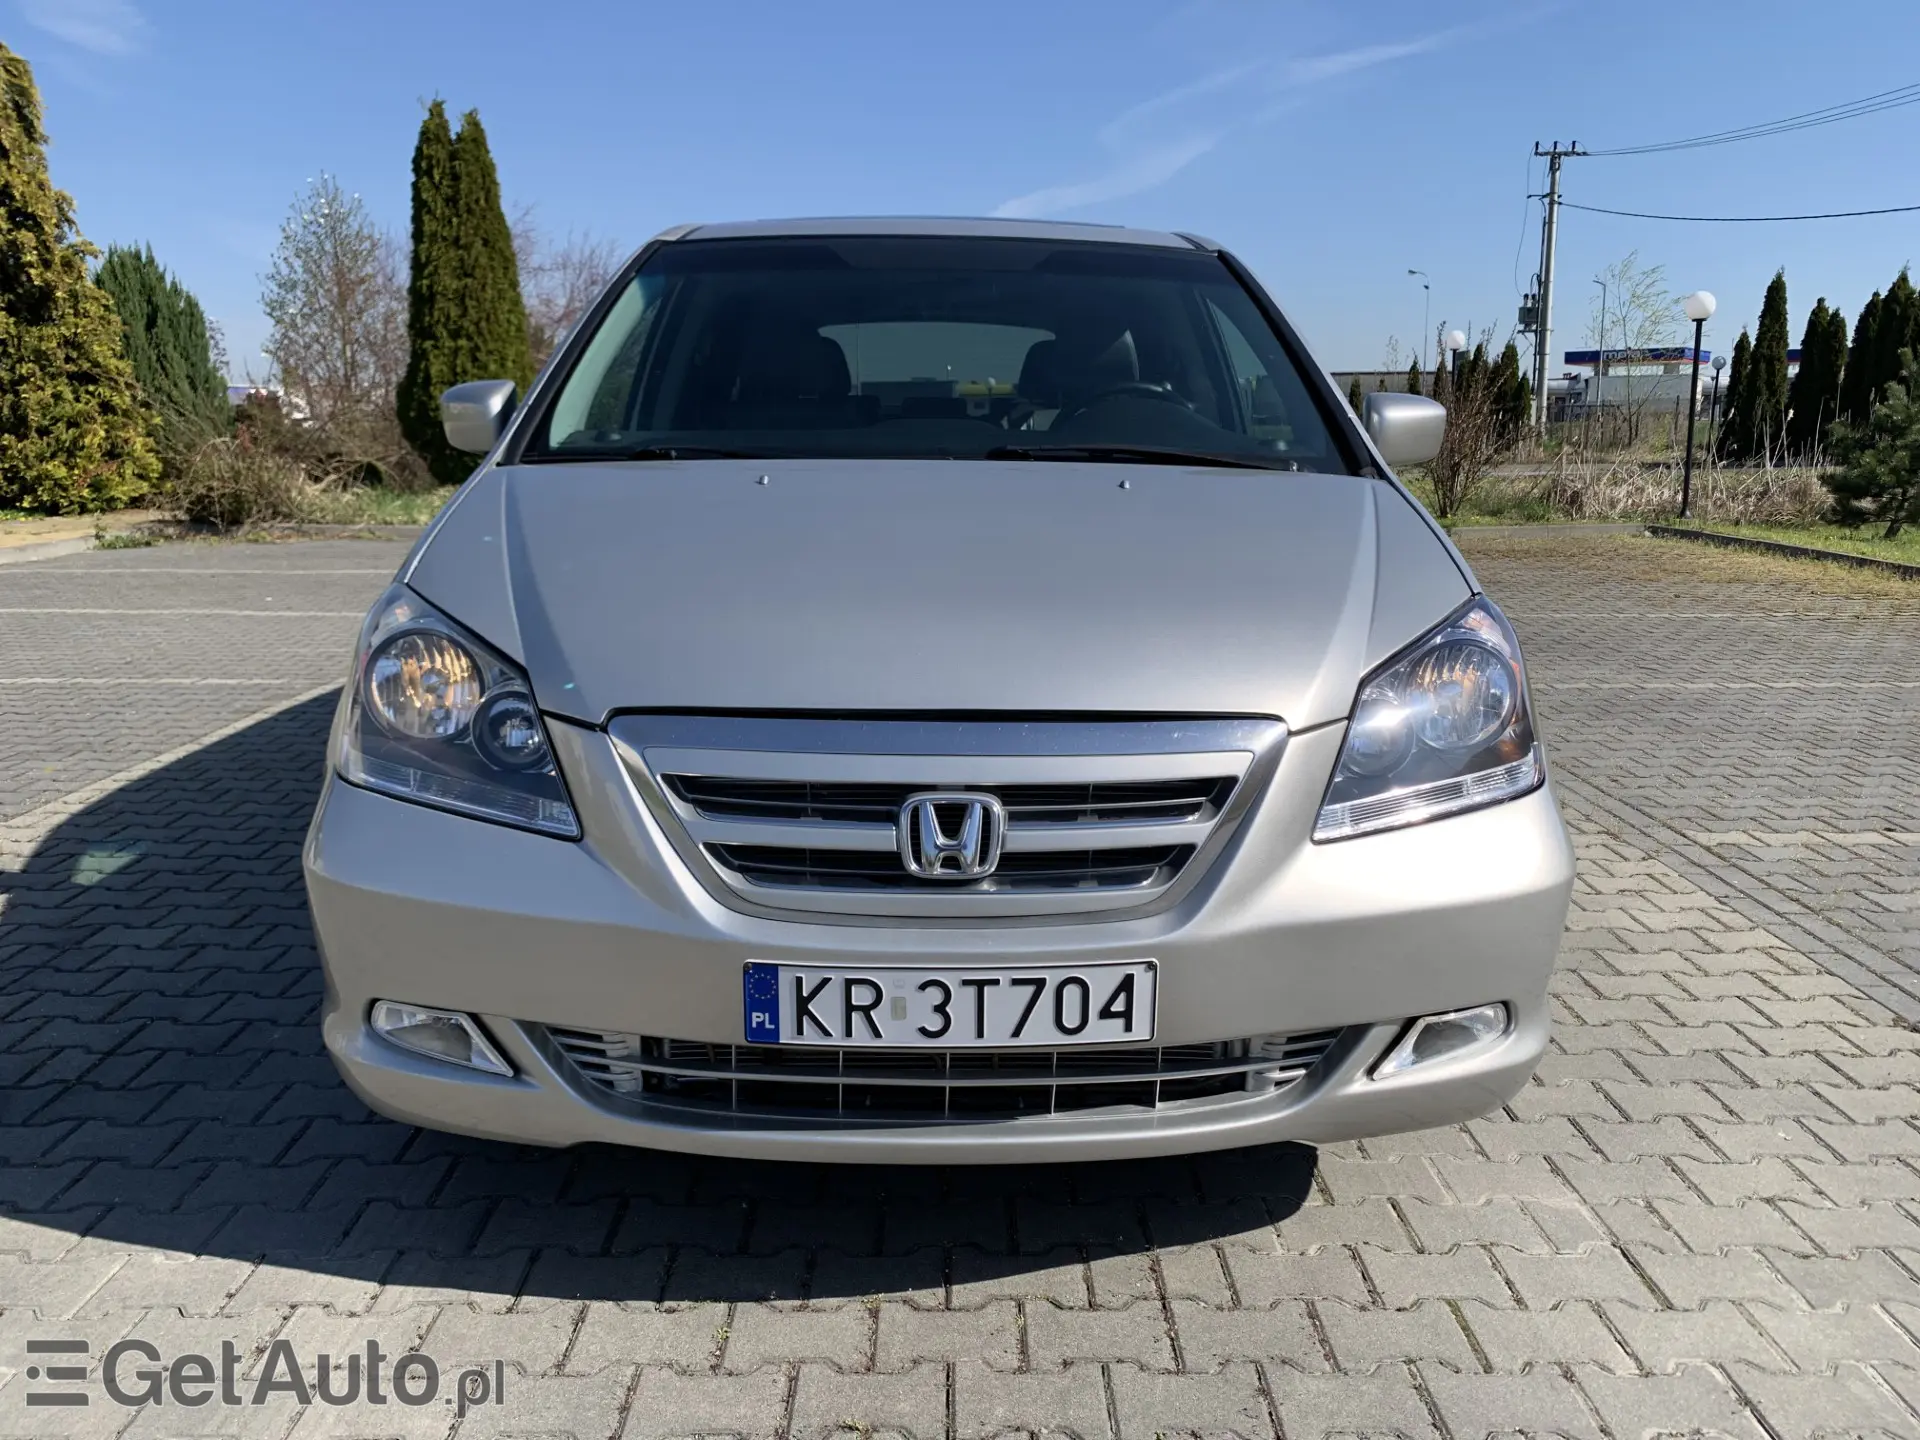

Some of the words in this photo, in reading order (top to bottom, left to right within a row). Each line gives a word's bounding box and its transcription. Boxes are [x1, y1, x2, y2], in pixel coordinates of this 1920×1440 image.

[752, 1012, 775, 1029] PL
[795, 975, 885, 1038] KR
[917, 973, 1136, 1039] 3T704
